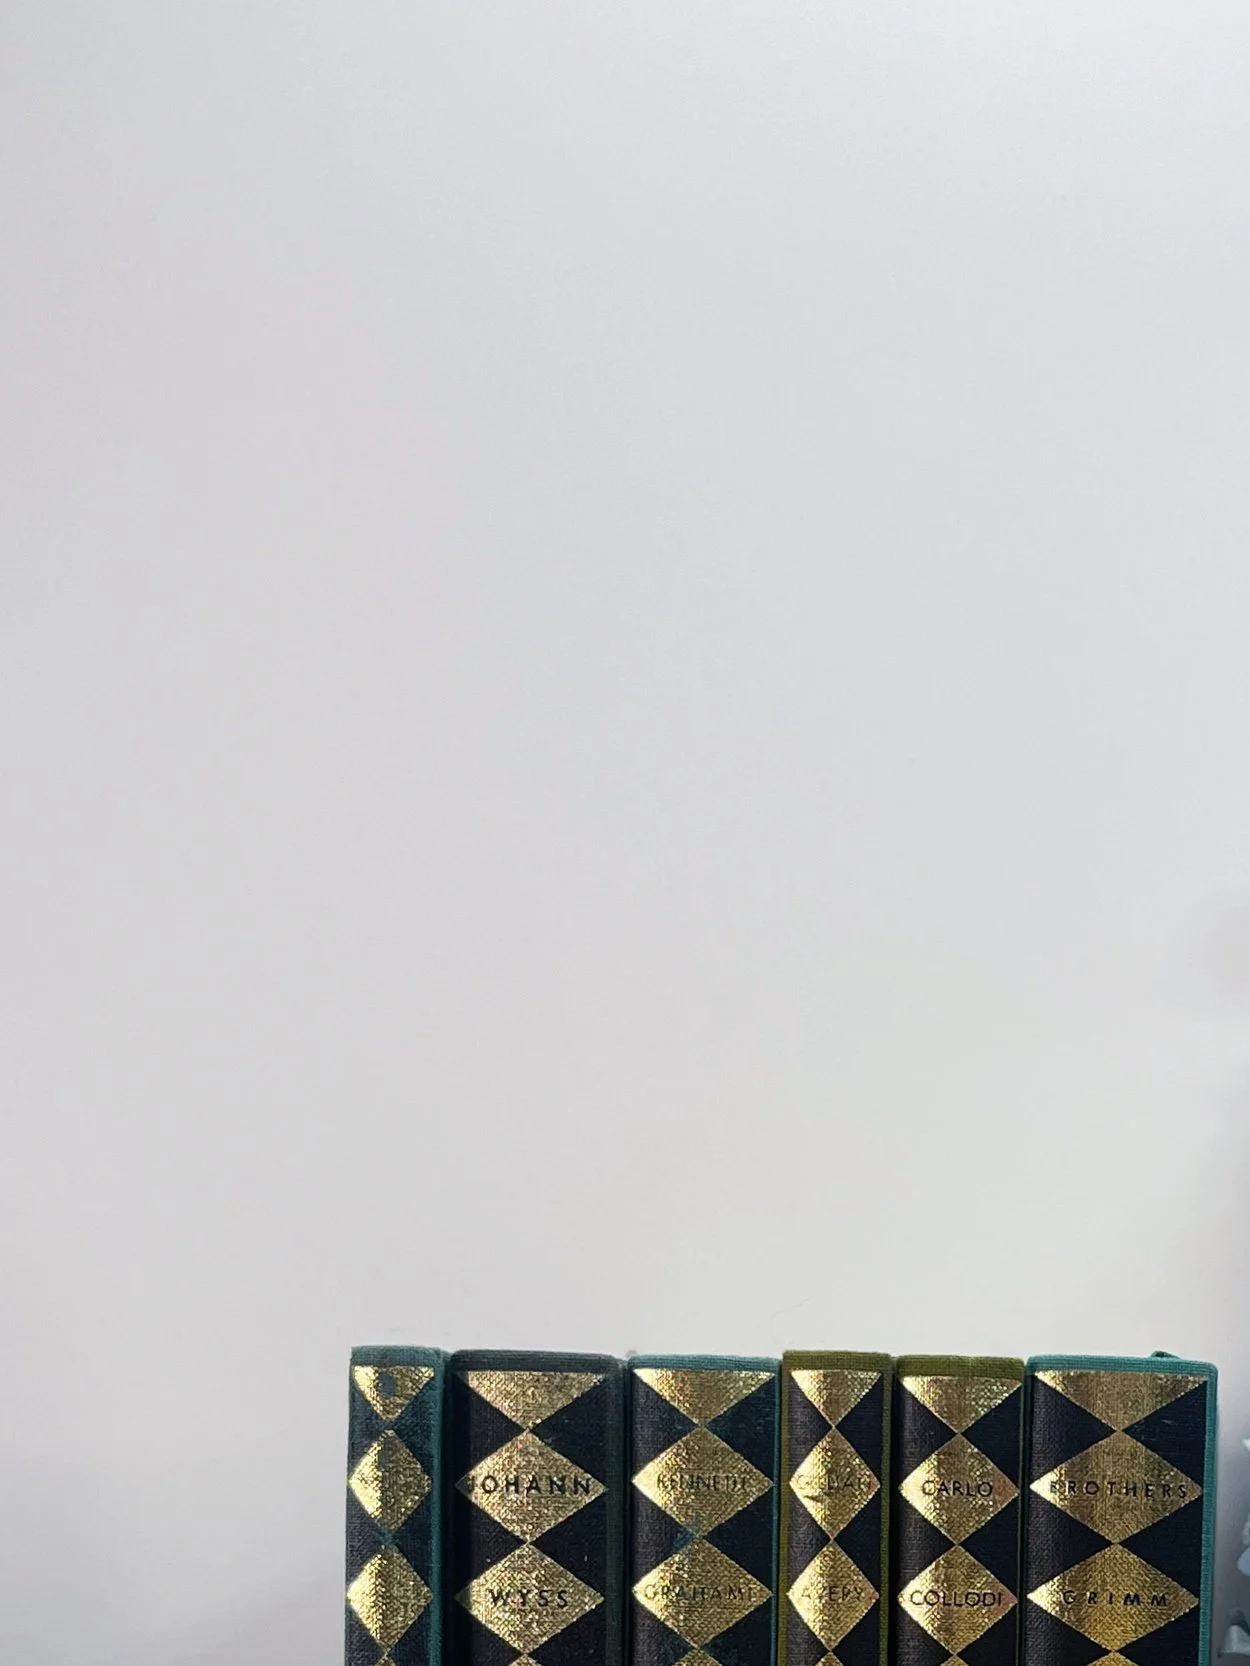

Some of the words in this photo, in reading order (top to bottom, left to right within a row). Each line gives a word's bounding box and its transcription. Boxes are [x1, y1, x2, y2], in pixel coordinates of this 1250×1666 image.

[921, 1480, 994, 1498] CARLO
[1050, 1480, 1189, 1500] BROTHERS
[490, 1590, 569, 1609] WYSS
[909, 1590, 1005, 1608] COLLODI
[1062, 1590, 1168, 1608] GRIMM
